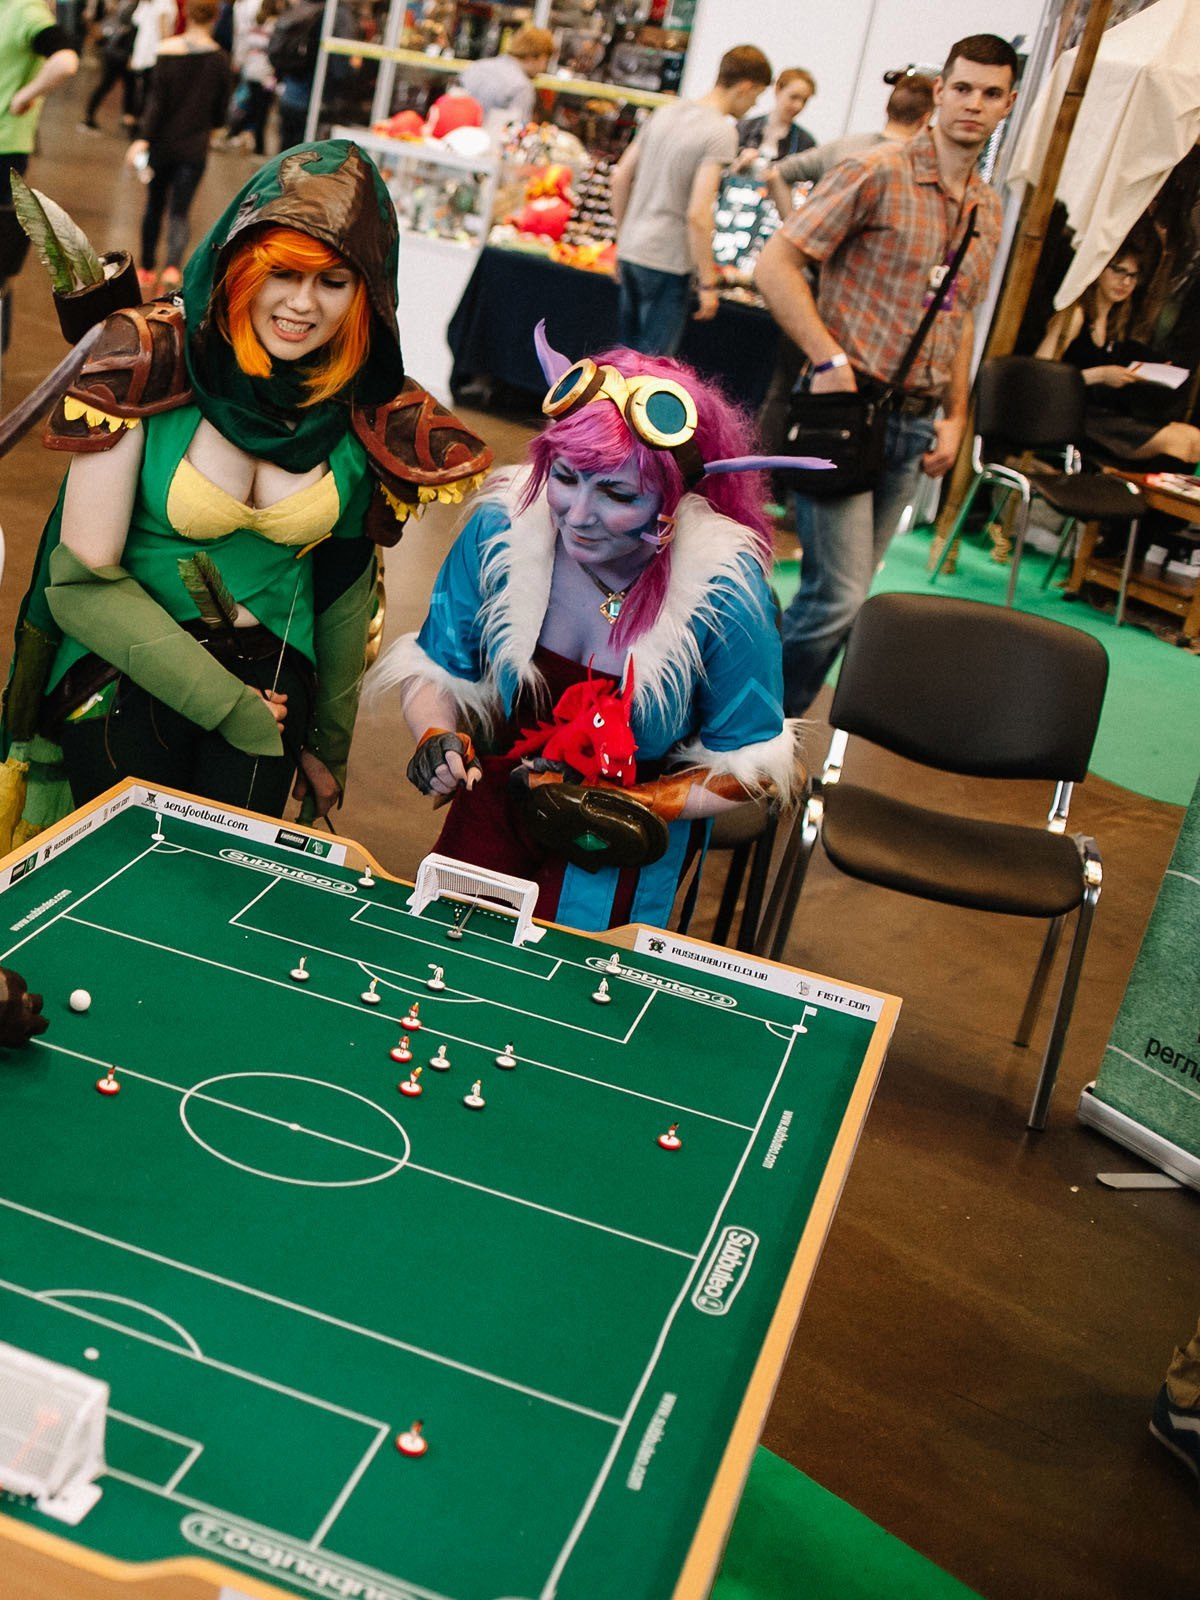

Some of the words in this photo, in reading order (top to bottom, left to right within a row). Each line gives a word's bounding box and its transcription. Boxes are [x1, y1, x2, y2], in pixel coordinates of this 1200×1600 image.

[163, 799, 249, 832] sensfootball.com
[227, 850, 332, 887] Subbuteo
[817, 989, 871, 1013] FISTF.COM
[762, 1110, 794, 1169] www.subbuteo.com
[704, 1231, 752, 1298] Subbuteo
